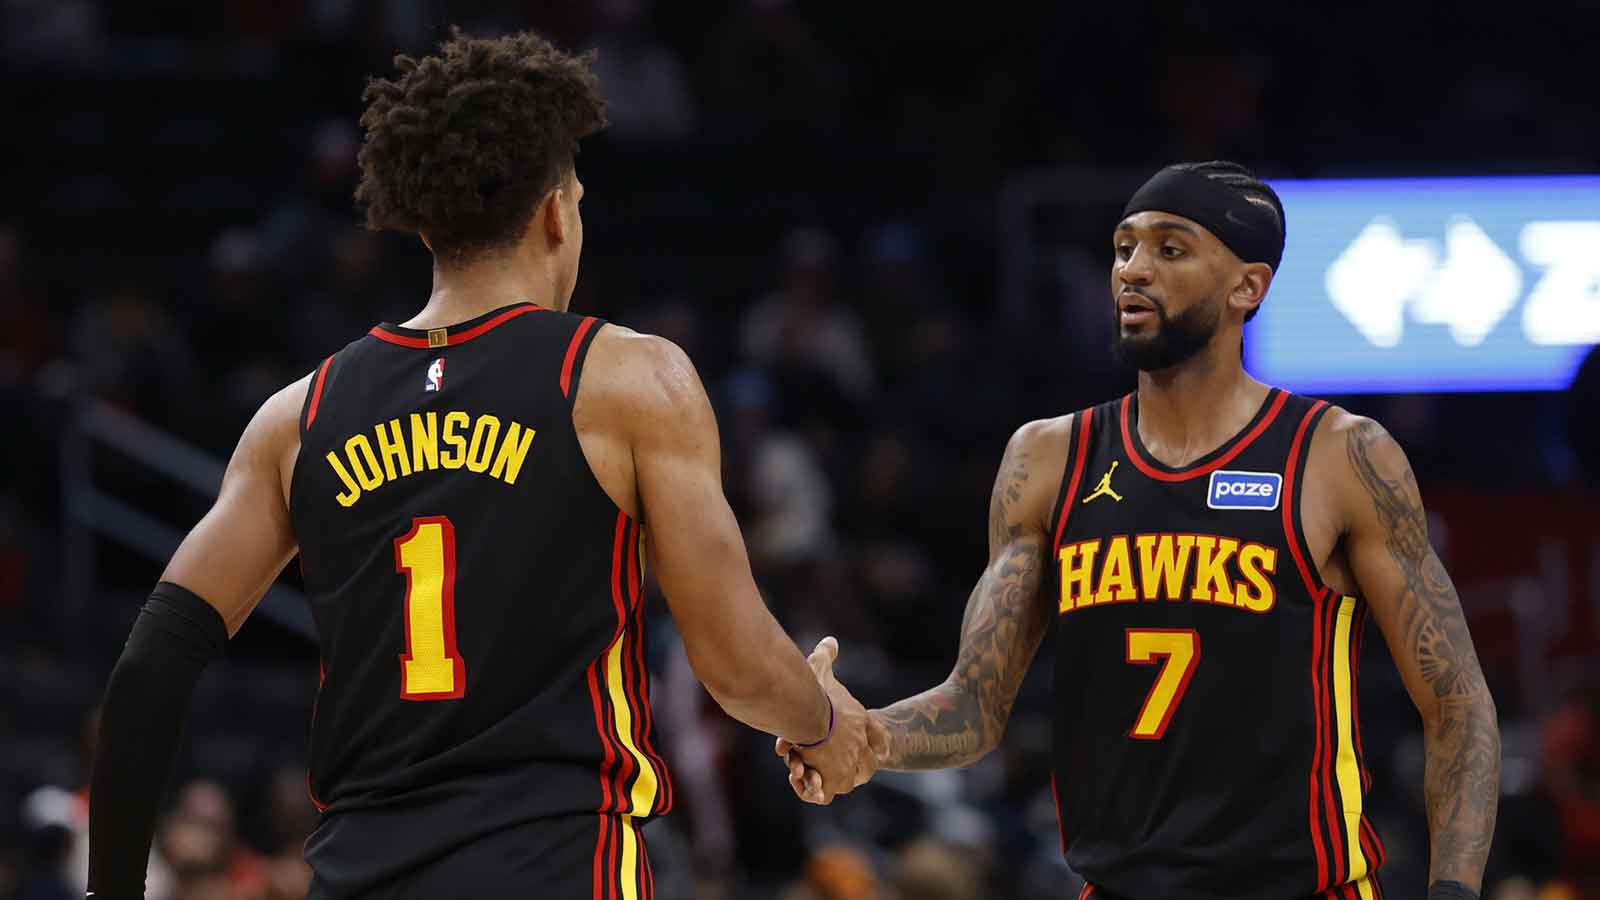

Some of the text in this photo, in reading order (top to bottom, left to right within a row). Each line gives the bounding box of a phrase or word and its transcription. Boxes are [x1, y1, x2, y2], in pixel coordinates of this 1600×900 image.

[326, 411, 536, 507] JOHNSON
[1215, 481, 1274, 499] paze
[394, 516, 465, 701] 1
[1058, 532, 1278, 614] HAWKS
[1126, 628, 1201, 740] 7
